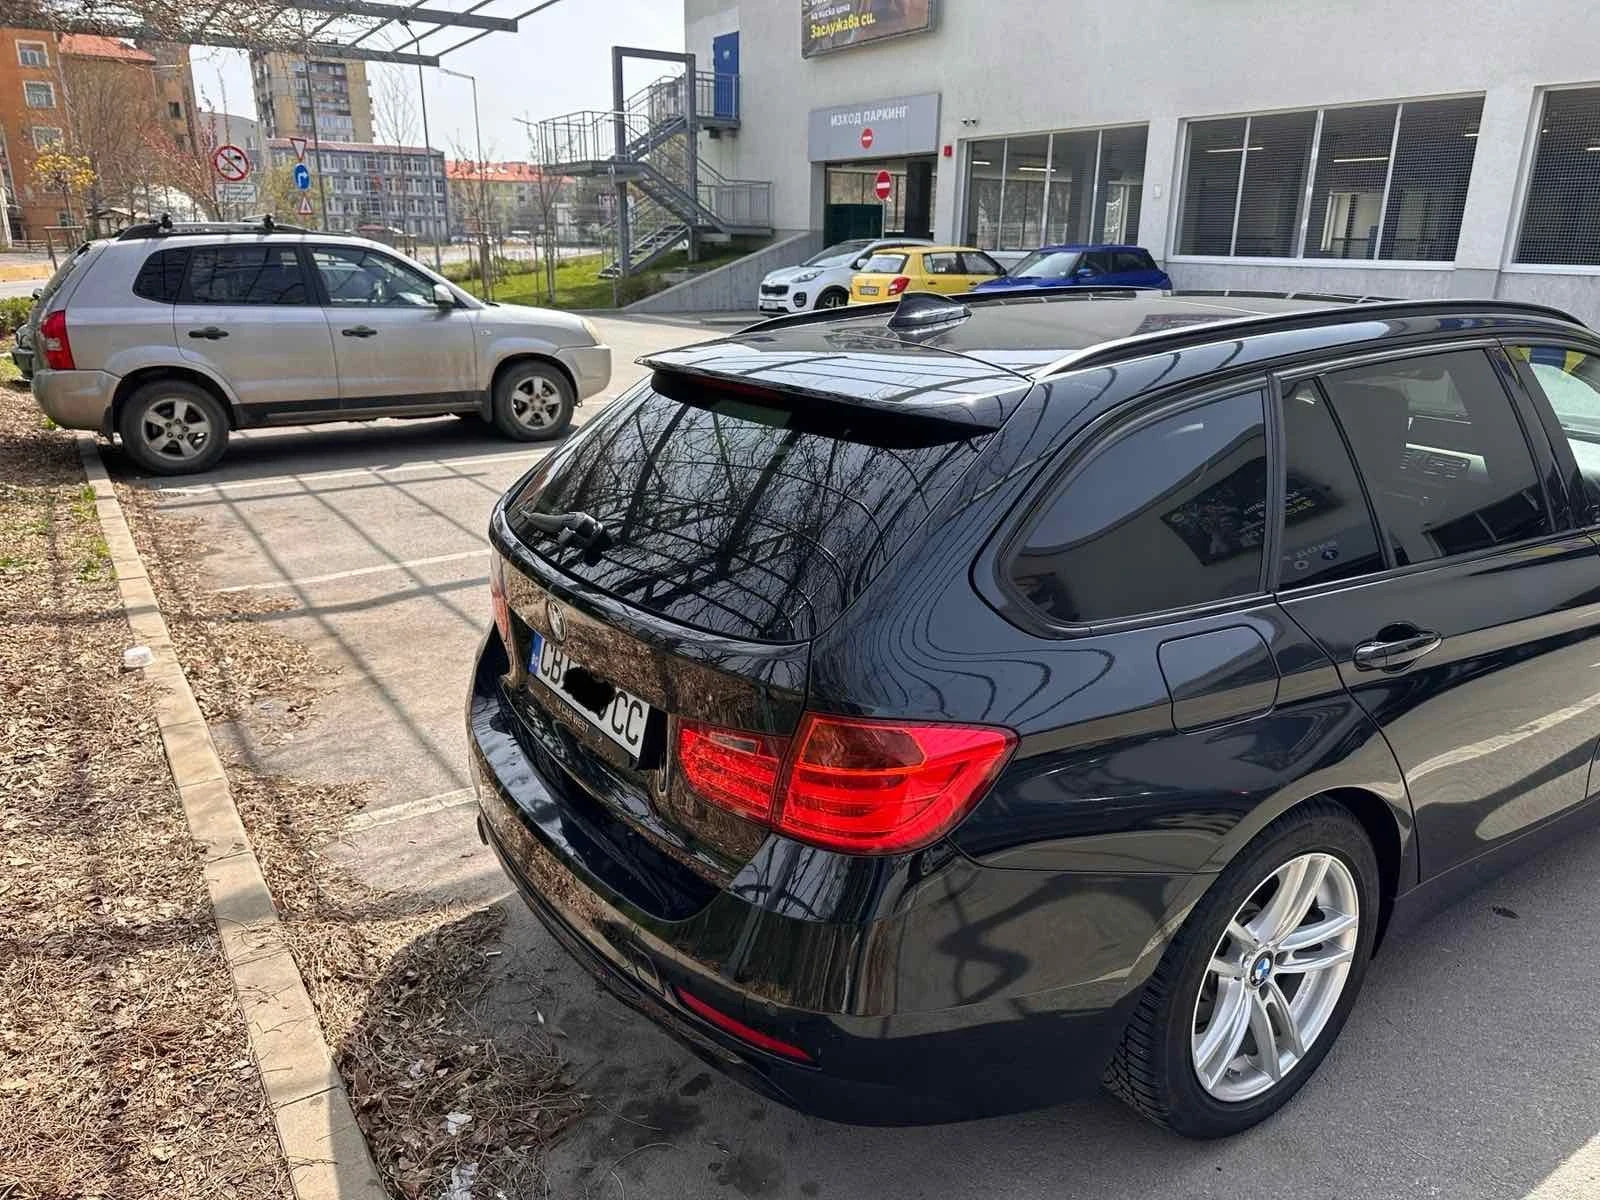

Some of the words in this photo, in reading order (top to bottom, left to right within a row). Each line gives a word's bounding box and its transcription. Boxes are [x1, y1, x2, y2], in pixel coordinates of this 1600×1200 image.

[810, 14, 860, 39] Заслужава
[861, 12, 876, 26] си.
[830, 111, 861, 126] ИЗХОД
[863, 104, 910, 120] ПАРКИНГ
